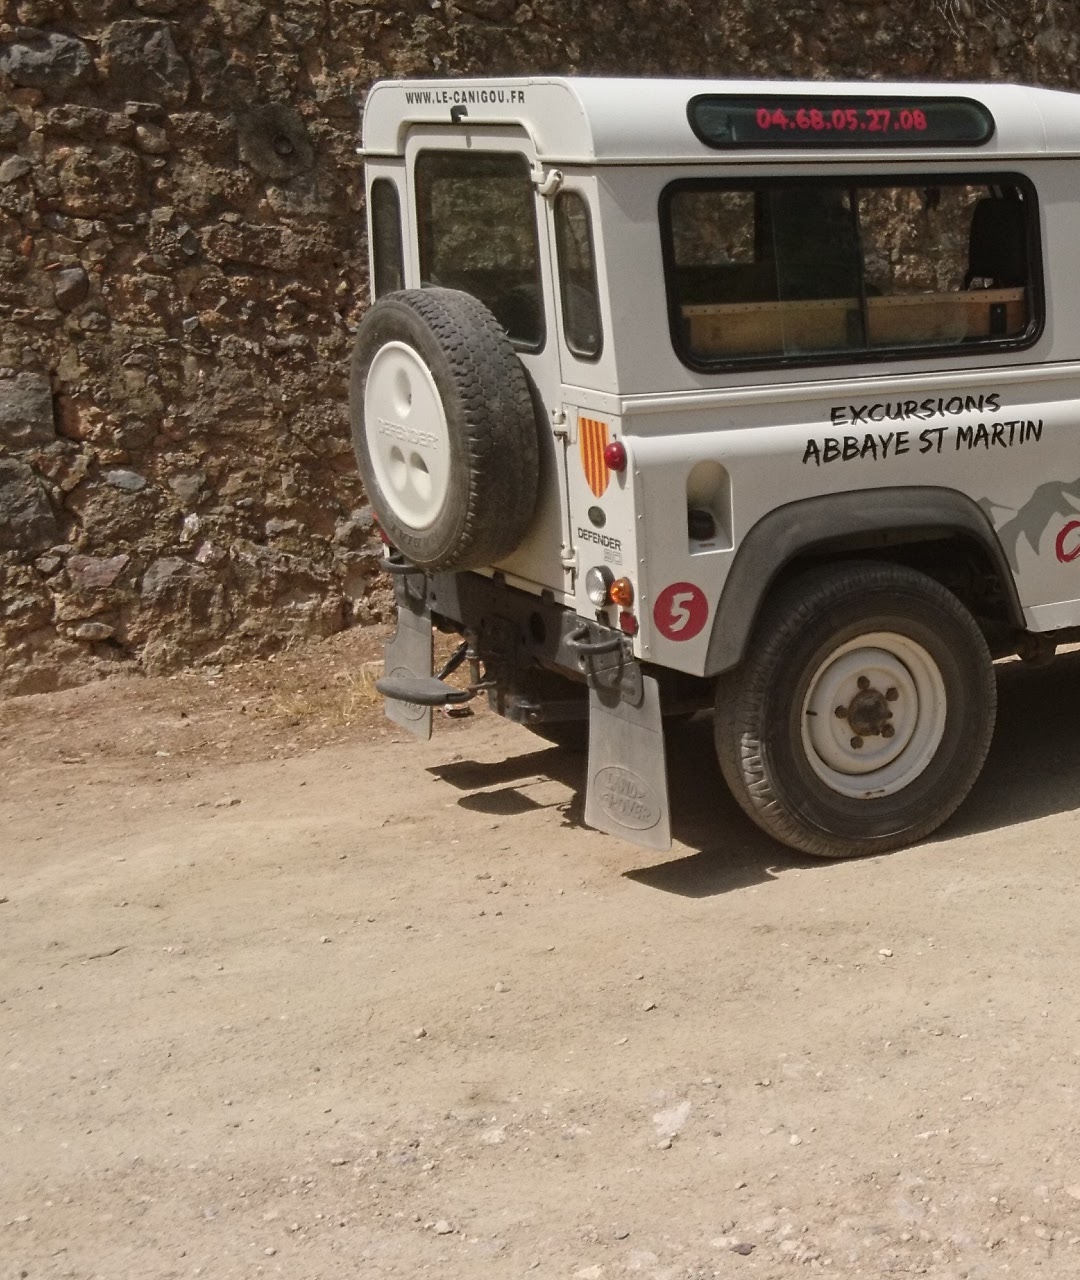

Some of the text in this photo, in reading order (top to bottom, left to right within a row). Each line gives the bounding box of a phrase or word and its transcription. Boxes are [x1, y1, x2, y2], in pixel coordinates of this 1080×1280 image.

[405, 90, 525, 104] WWW.LE-CANIGOU.FR
[756, 107, 928, 132] 04.68.05.27.08
[830, 393, 1001, 426] EXCURSIONS
[802, 419, 1044, 466] ABBAYE ST MARTIN
[577, 527, 622, 551] DEFENDER
[669, 591, 695, 633] 5
